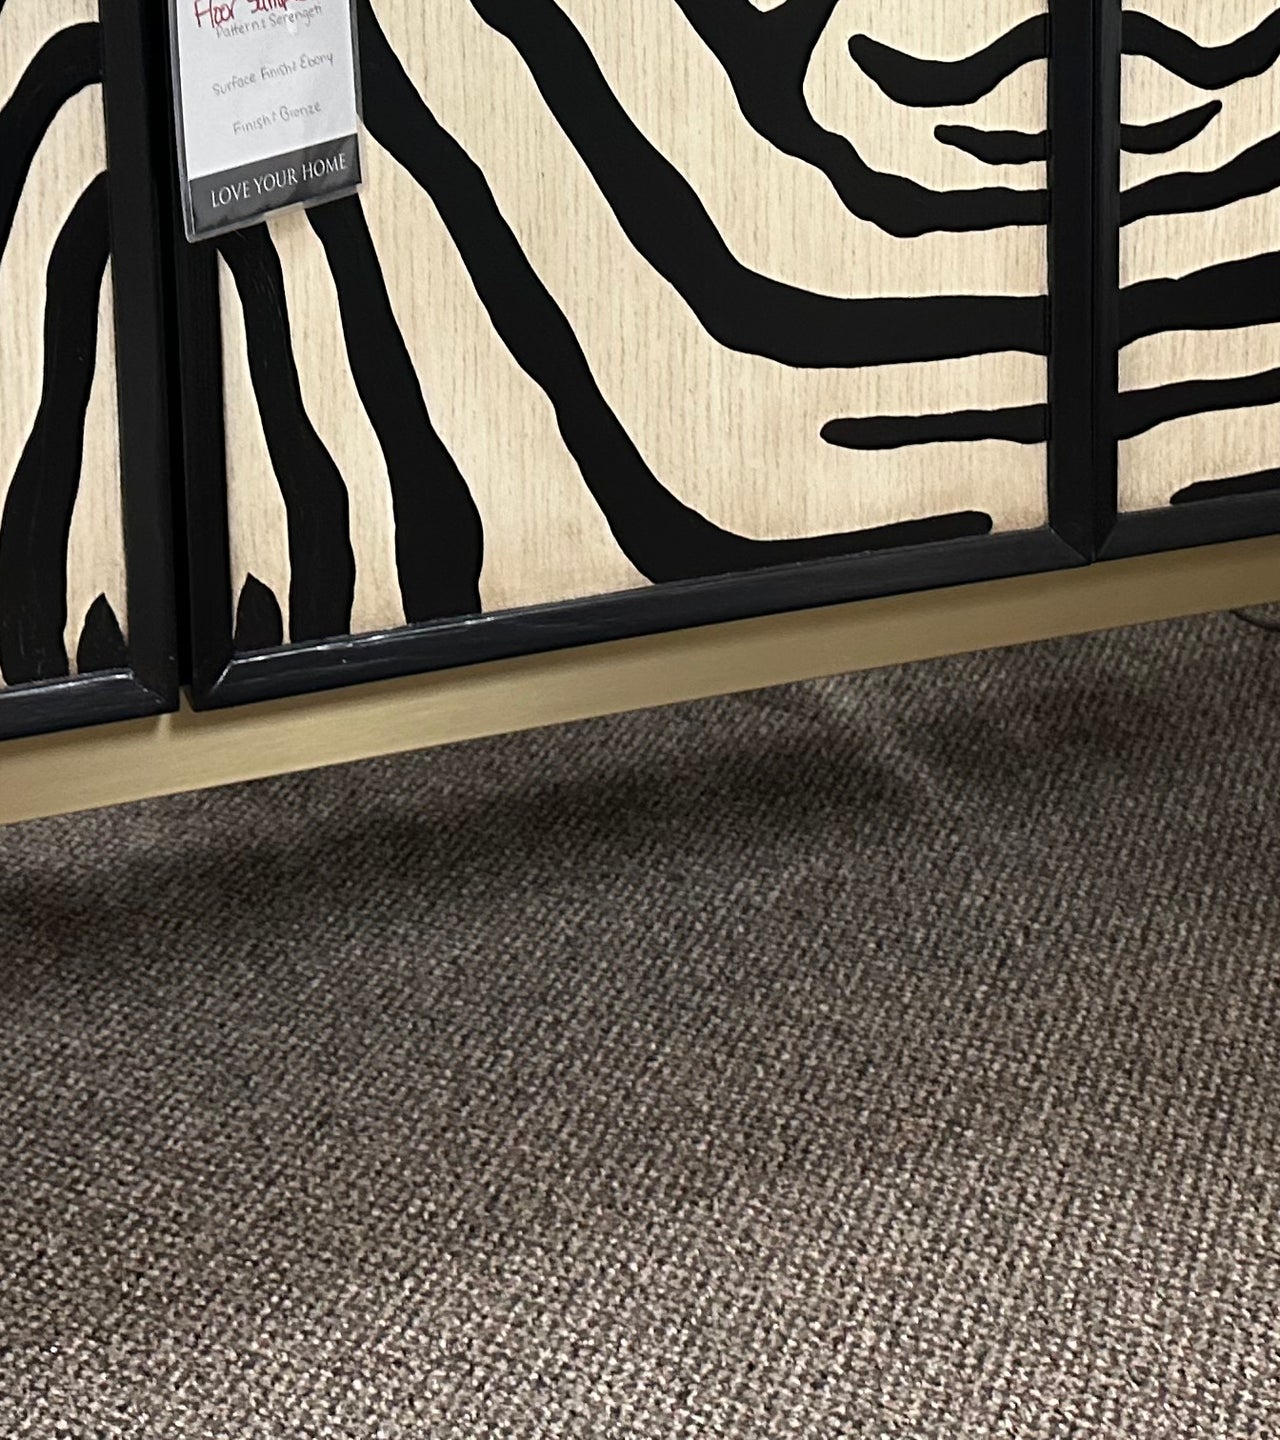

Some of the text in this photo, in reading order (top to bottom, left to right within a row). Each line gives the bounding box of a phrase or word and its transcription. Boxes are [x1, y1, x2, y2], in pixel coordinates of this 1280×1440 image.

[212, 73, 257, 97] Surface
[211, 152, 348, 208] LOVE YOUR HOME
